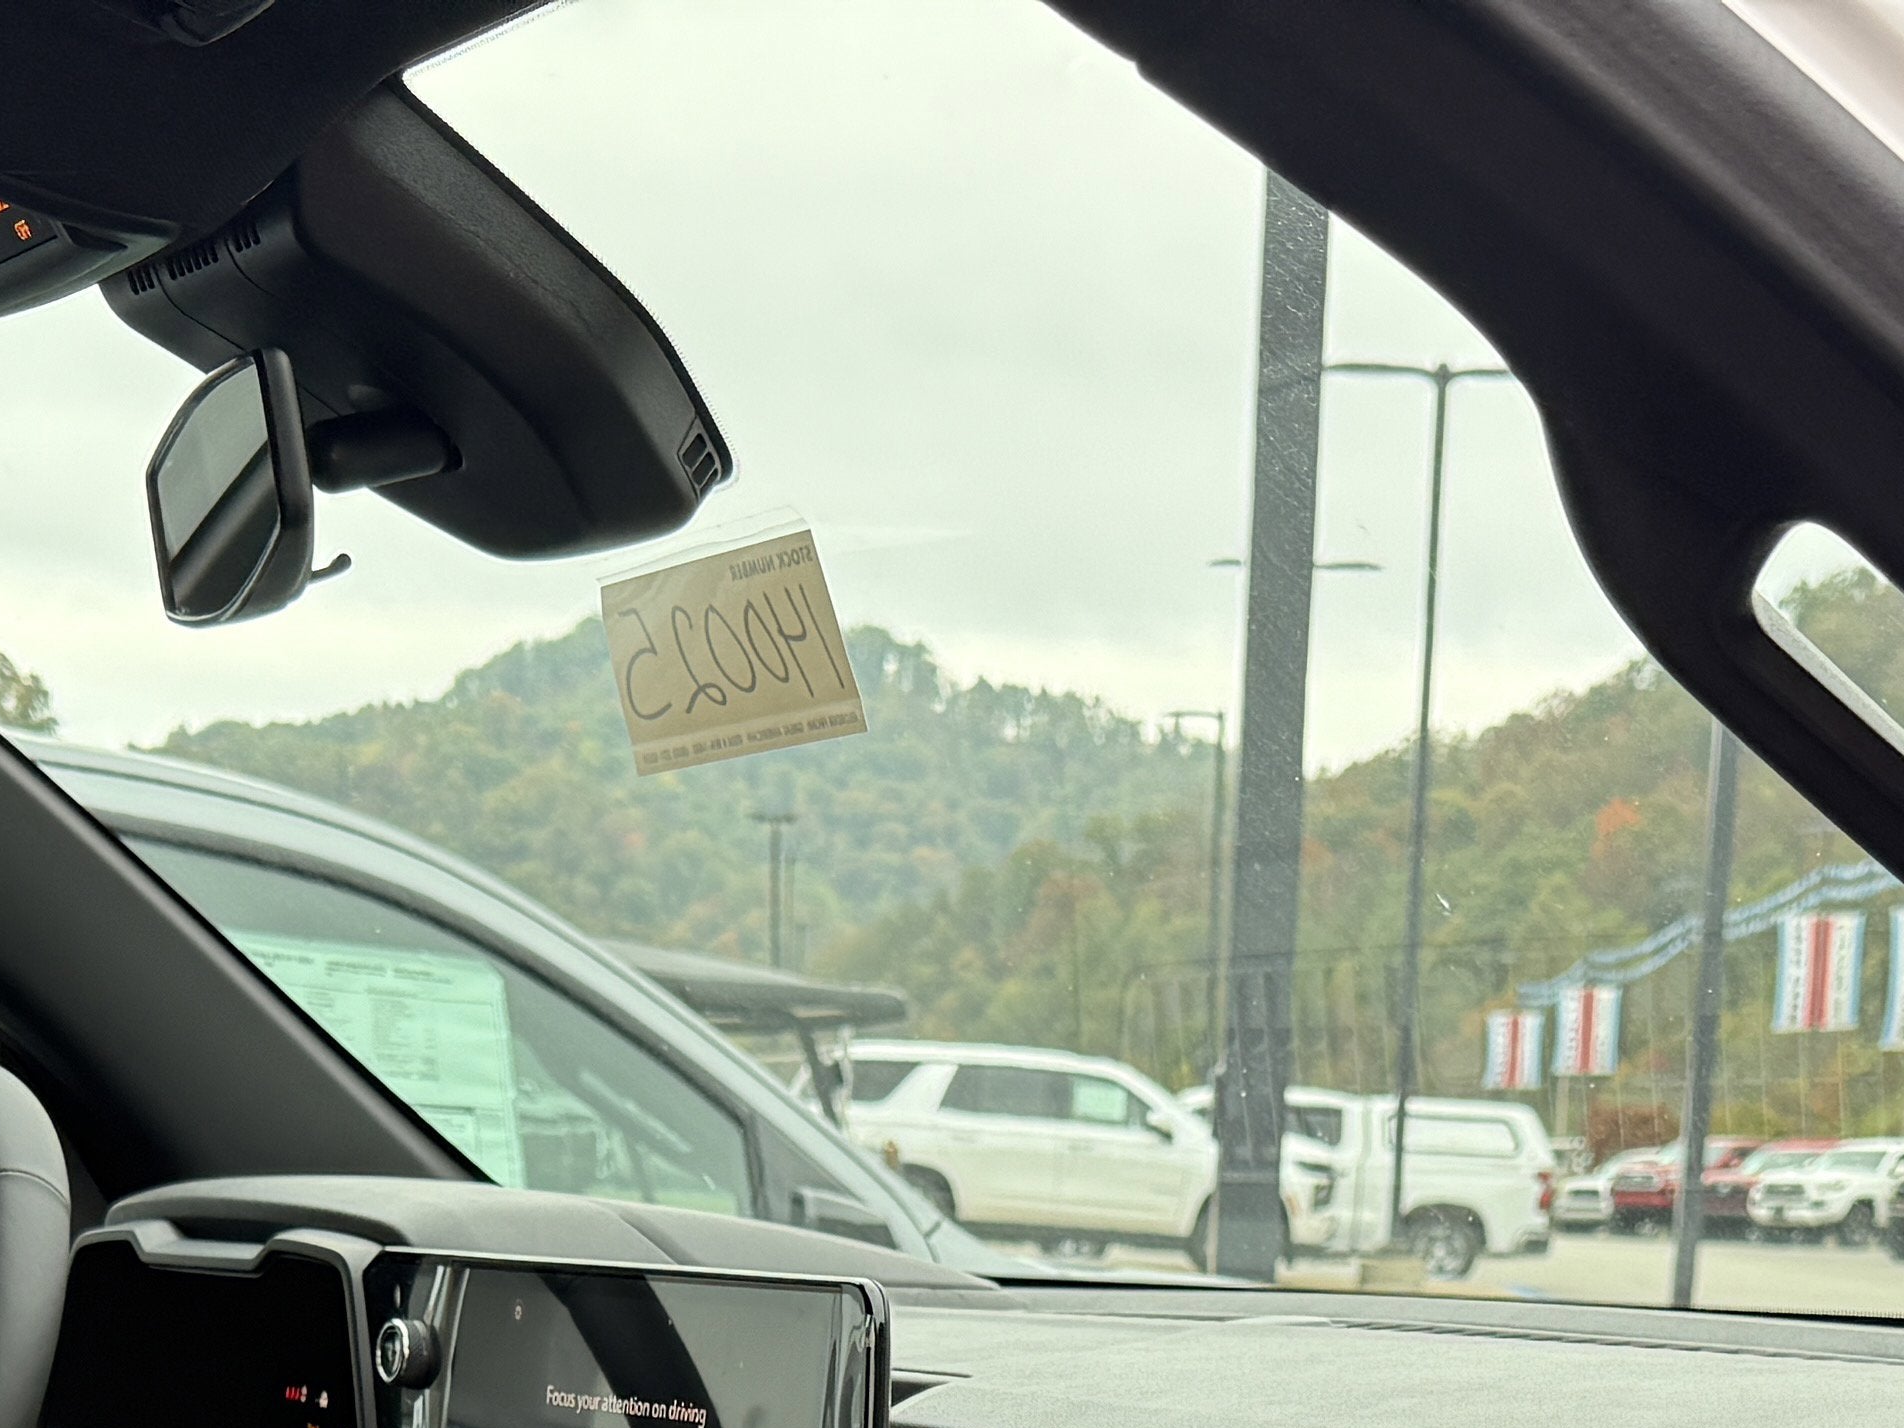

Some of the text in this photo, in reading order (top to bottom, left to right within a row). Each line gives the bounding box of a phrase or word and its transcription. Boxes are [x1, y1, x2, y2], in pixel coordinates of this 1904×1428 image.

[546, 1385, 575, 1408] Focus
[576, 1395, 600, 1414] your
[601, 1393, 650, 1417] attention
[652, 1403, 666, 1420] on
